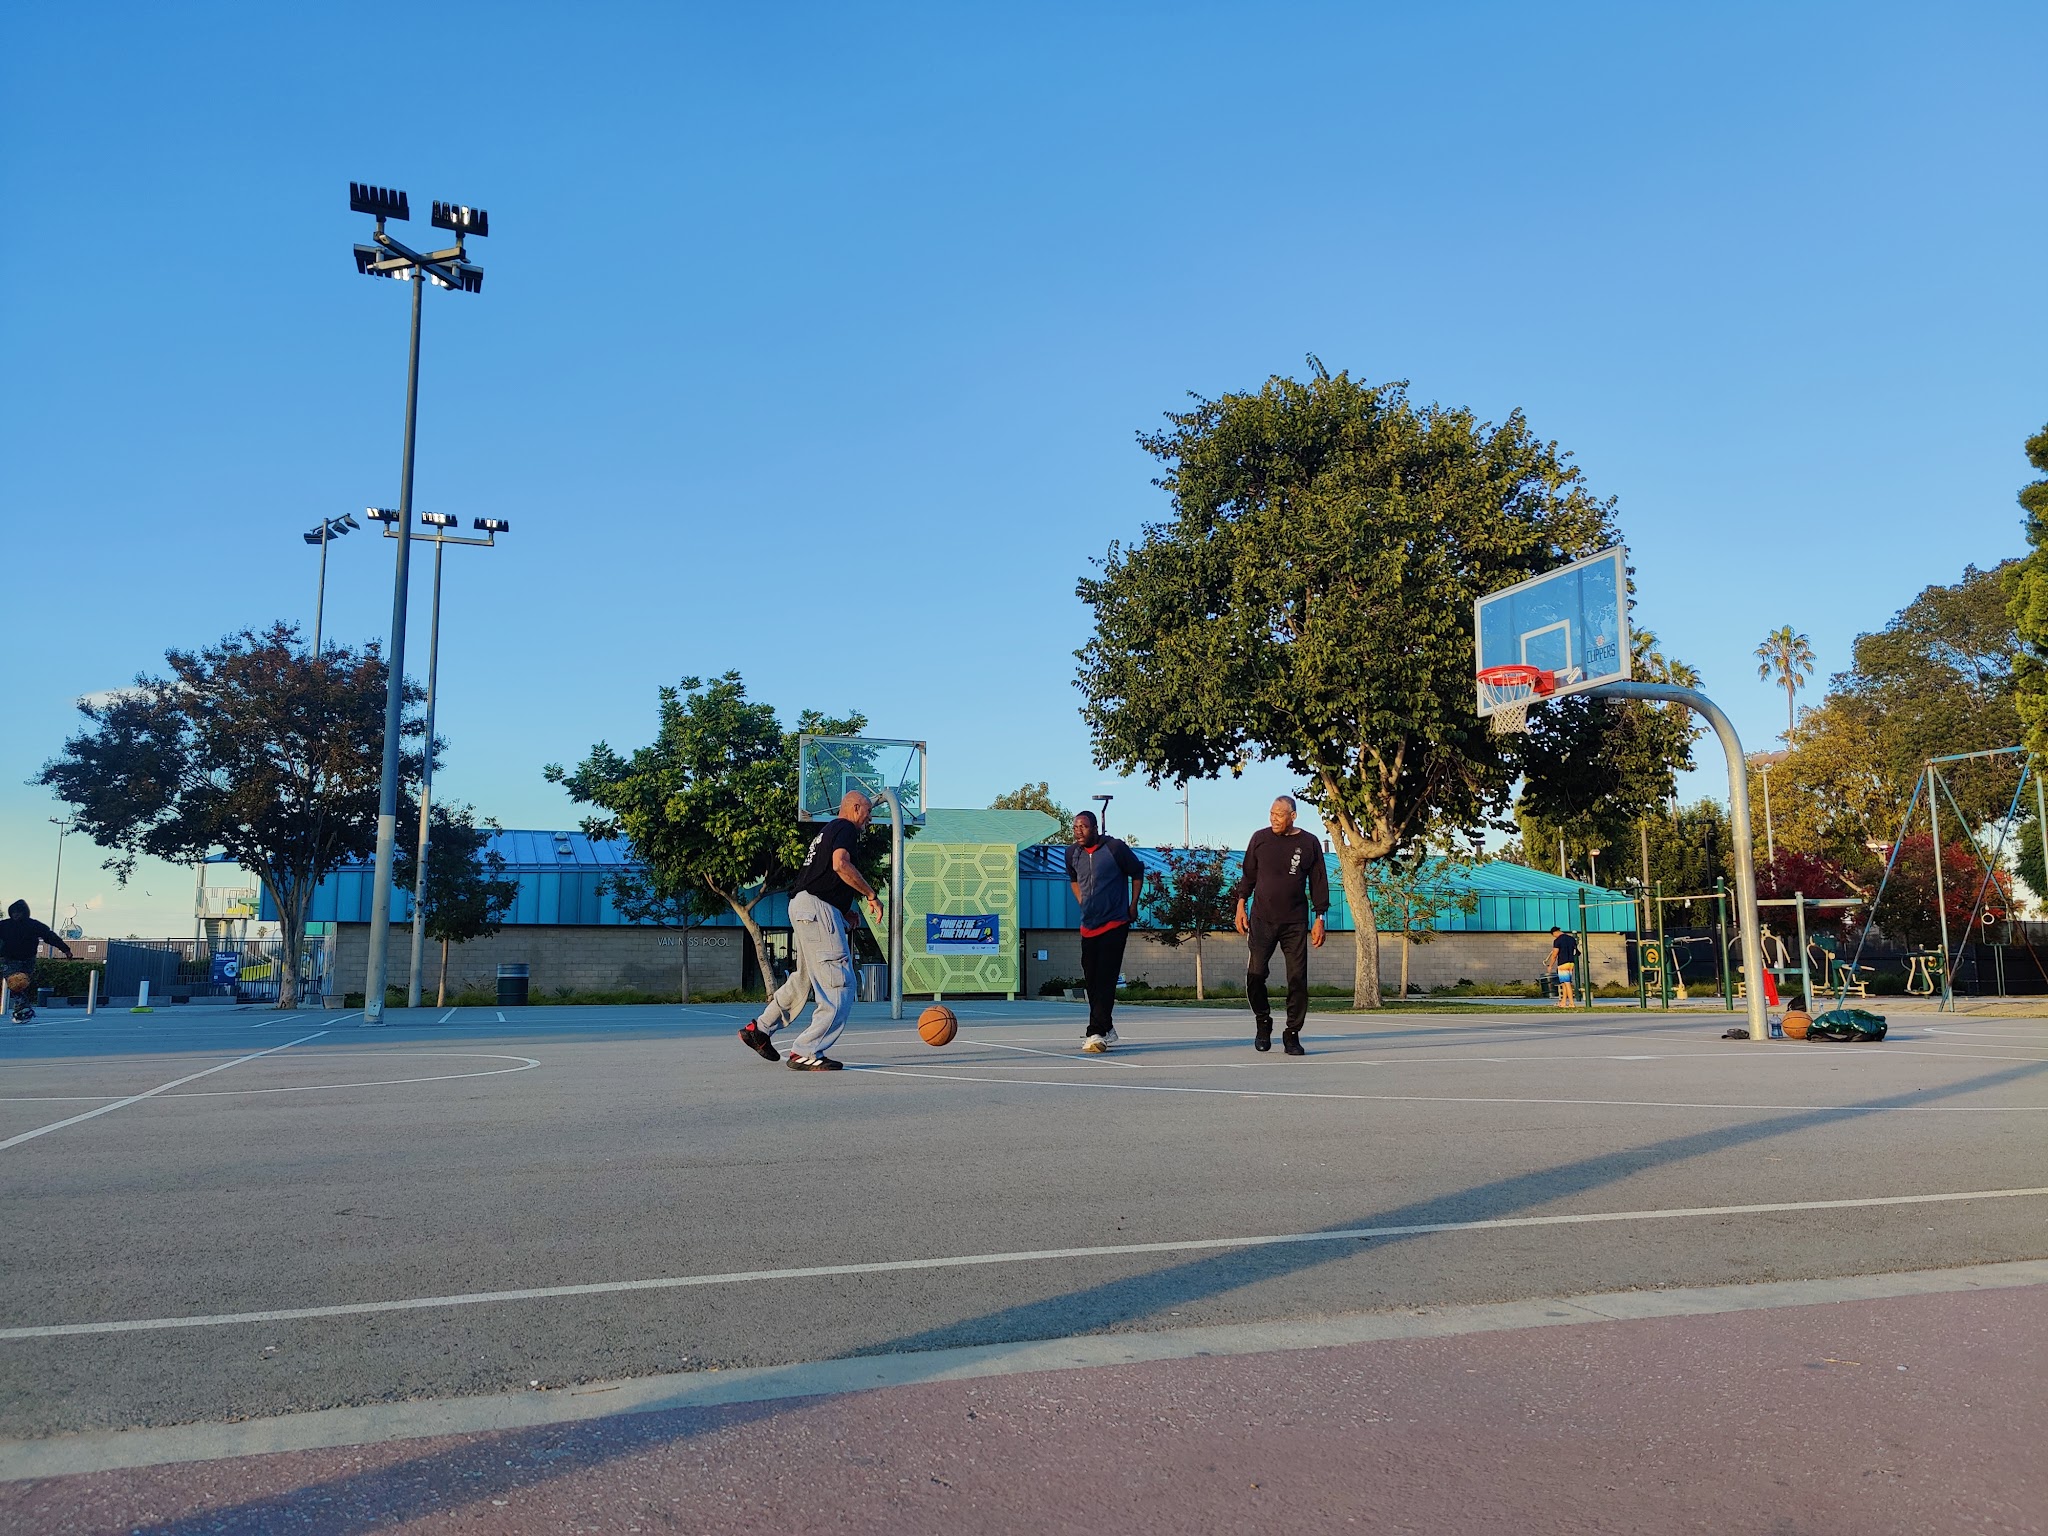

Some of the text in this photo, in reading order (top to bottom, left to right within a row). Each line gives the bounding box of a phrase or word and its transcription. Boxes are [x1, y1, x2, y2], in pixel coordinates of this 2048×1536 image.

[1586, 643, 1616, 664] CLIPPERS
[940, 919, 977, 929] NOW IS THE
[940, 928, 956, 939] TIME
[954, 928, 965, 939] TO
[962, 928, 981, 939] PLAY
[657, 937, 730, 947] VAN NSS POOL
